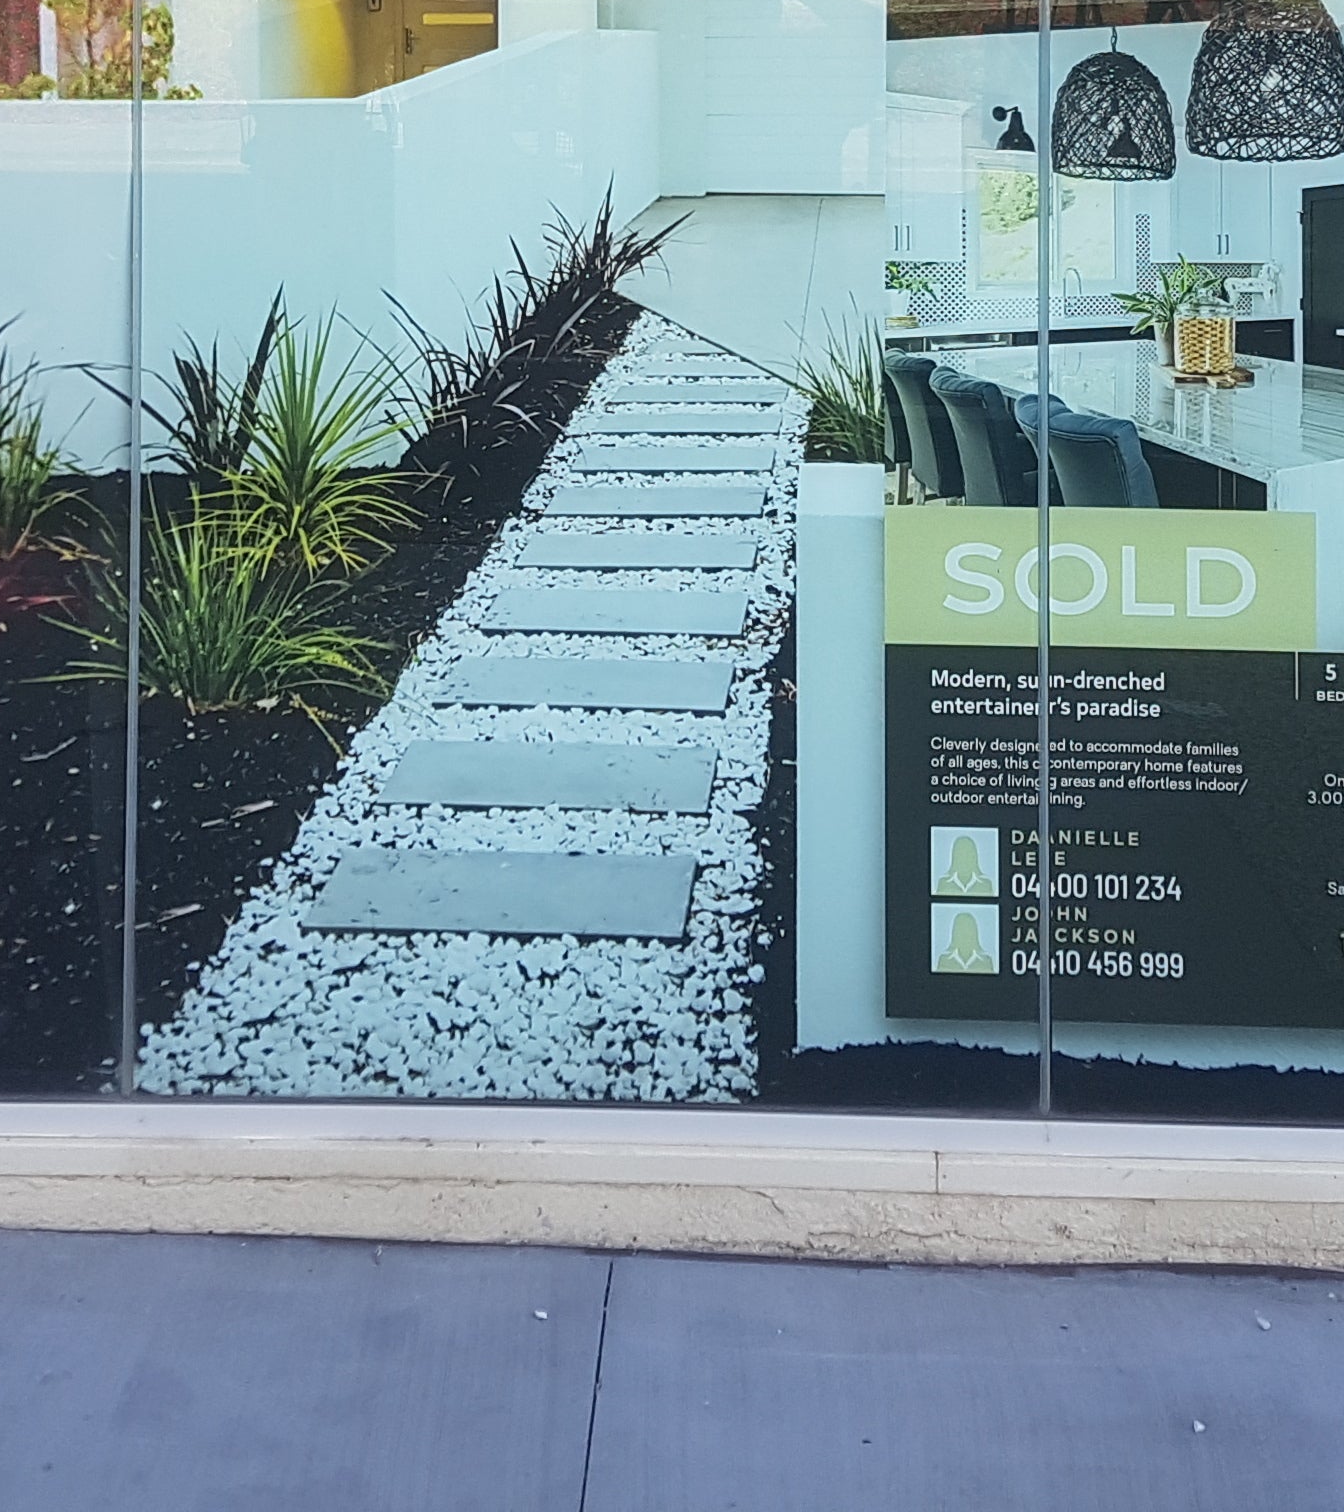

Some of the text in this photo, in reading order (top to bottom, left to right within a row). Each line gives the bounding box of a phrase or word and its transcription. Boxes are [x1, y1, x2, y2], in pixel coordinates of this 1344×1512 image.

[942, 542, 1258, 618] SOLD
[931, 669, 1165, 691] Modern, sun-drenched
[1325, 663, 1337, 681] 5
[931, 697, 1161, 721] entertainer's paradise
[931, 737, 1239, 756] Cleverly designed to accommodate families
[931, 754, 945, 767] of
[948, 755, 962, 768] all
[967, 758, 1001, 771] ages,
[1005, 756, 1029, 769] this
[1144, 758, 1183, 772] home
[1188, 760, 1243, 774] features
[931, 773, 1248, 795] a choice of living areas and effortless indoor/
[931, 790, 984, 804] outdoor
[1011, 830, 1139, 847] DANIELLE
[1011, 851, 1066, 866] LEE
[1094, 875, 1128, 900] 101
[1135, 875, 1182, 901] 234
[1011, 927, 1135, 944] JACKSON
[1088, 951, 1133, 976] 456
[1140, 952, 1184, 978] 999
